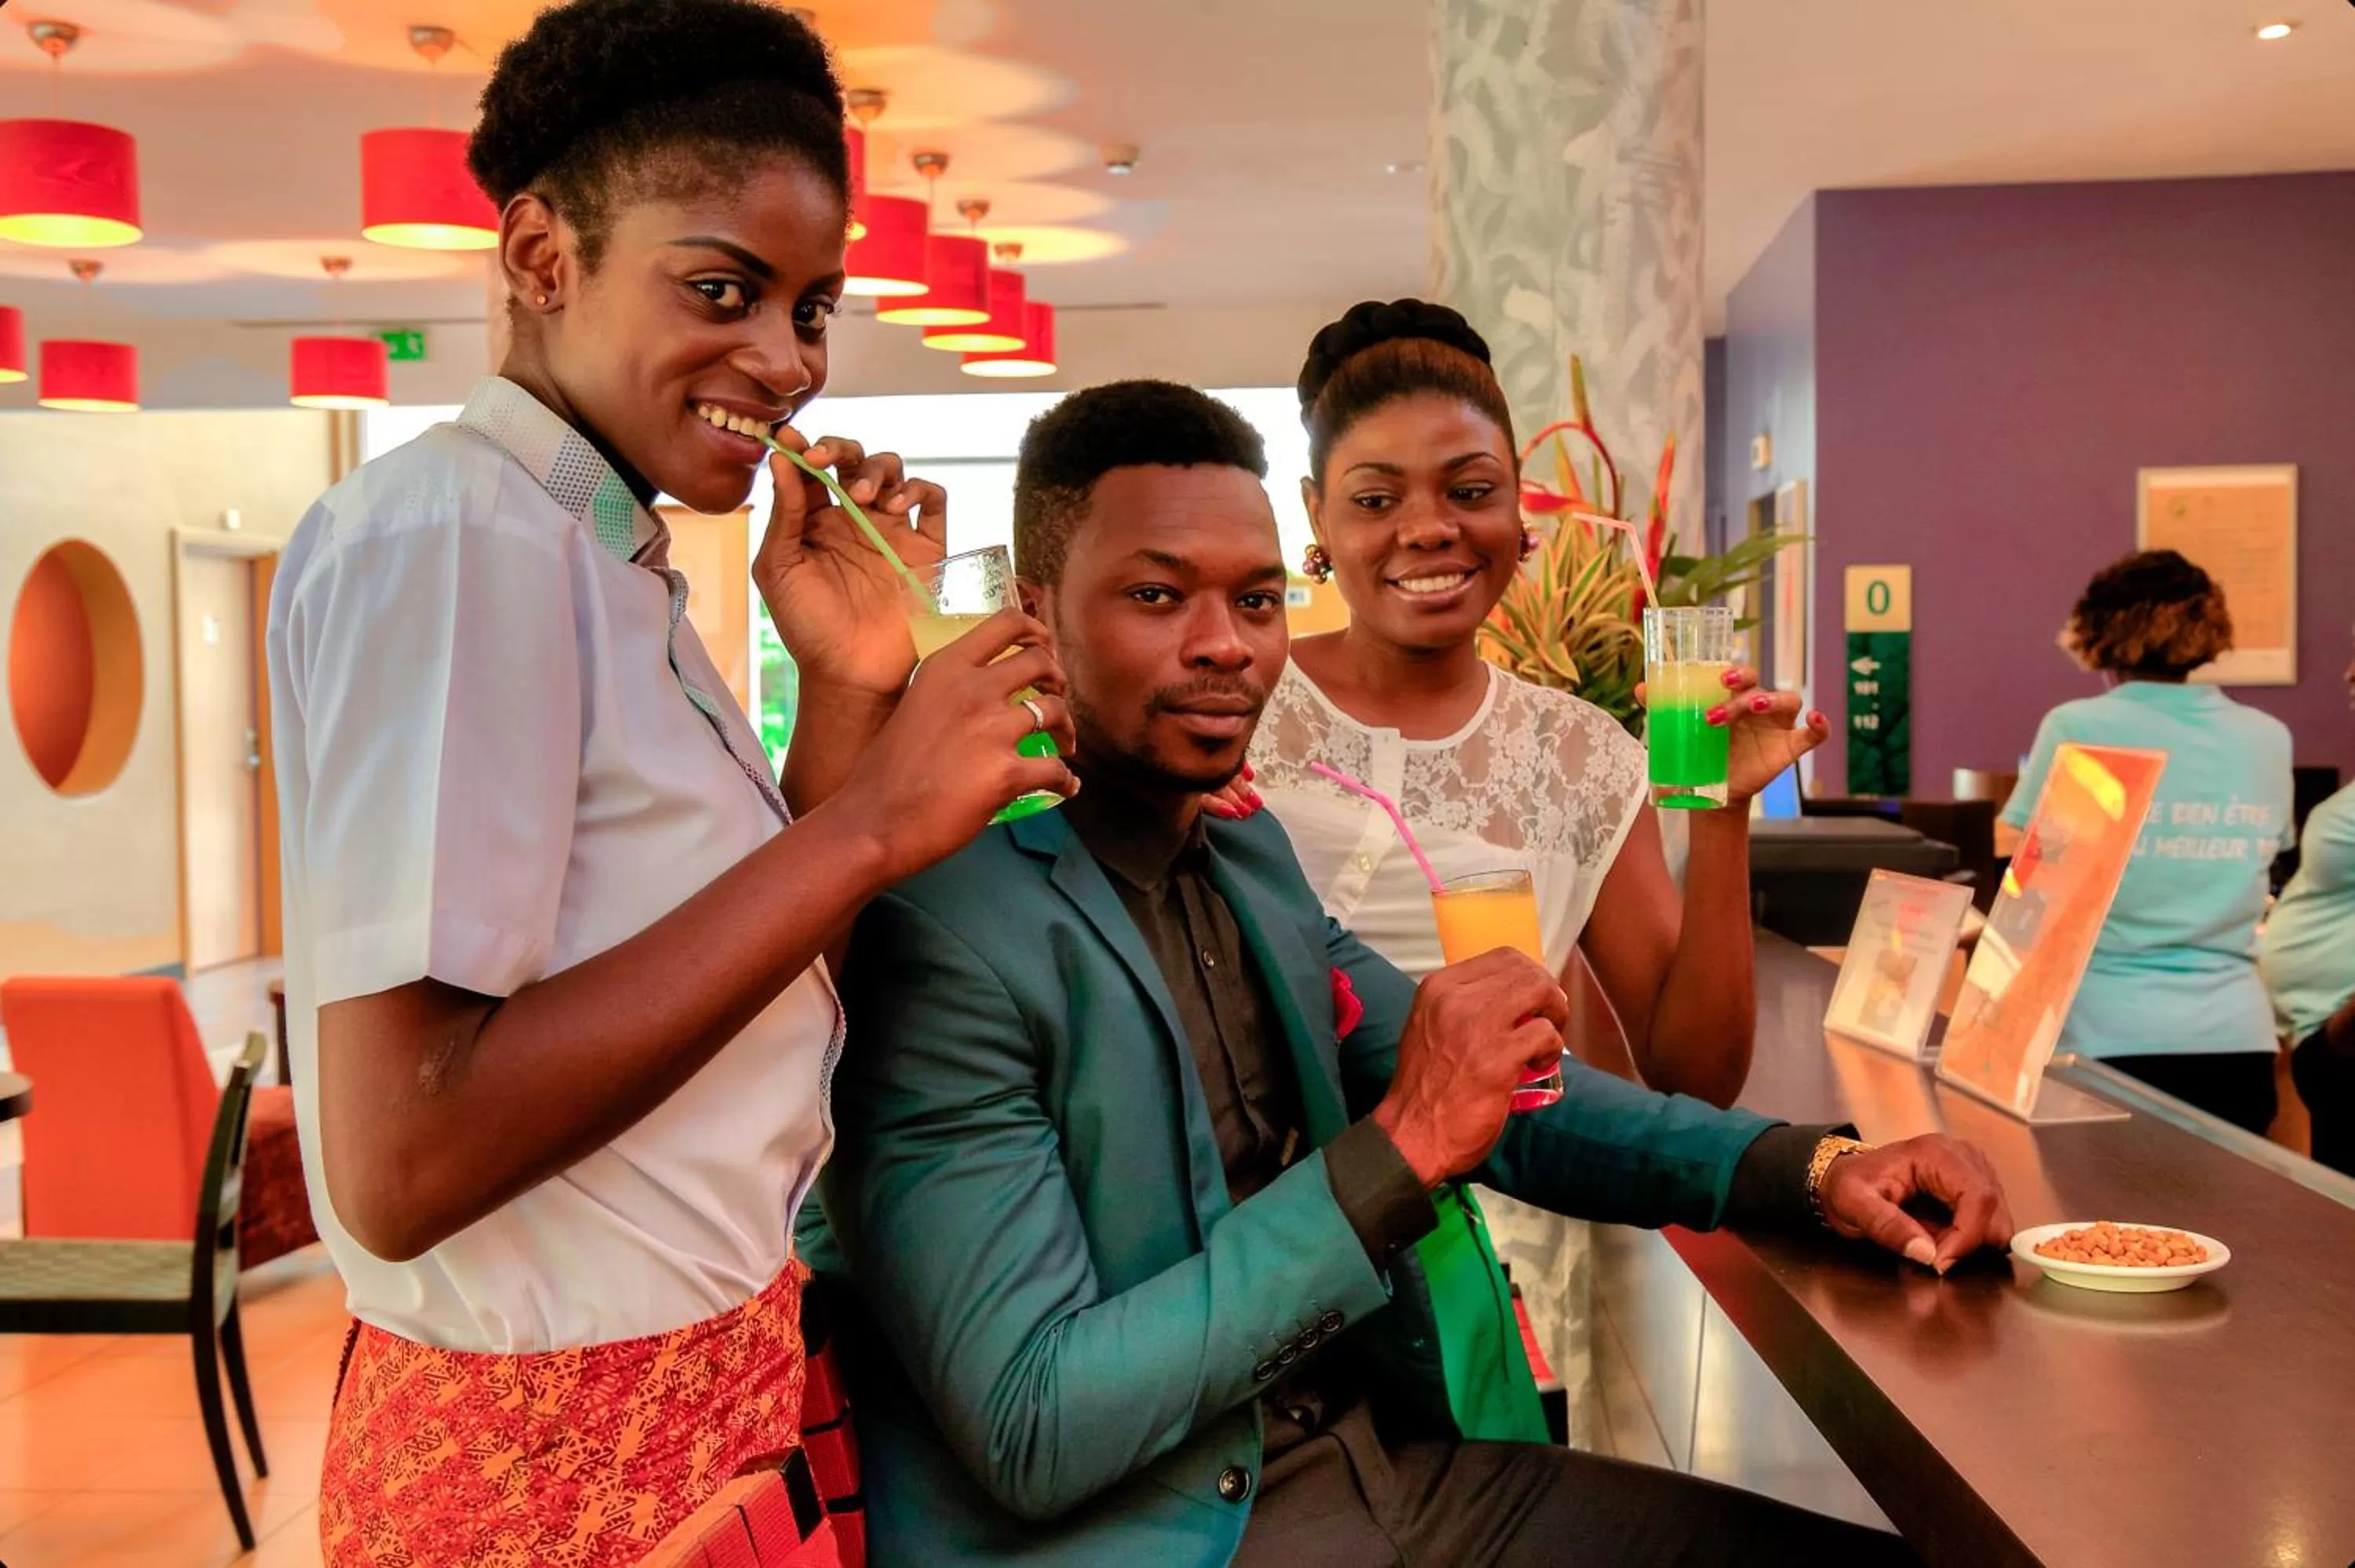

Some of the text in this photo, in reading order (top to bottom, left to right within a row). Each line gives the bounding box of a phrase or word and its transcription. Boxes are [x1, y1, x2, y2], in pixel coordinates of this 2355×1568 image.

[1867, 579, 1890, 616] 0
[2171, 802, 2219, 825] BIEN
[2223, 793, 2270, 826] ÊTRE
[2155, 835, 2249, 861] MEILLEUR
